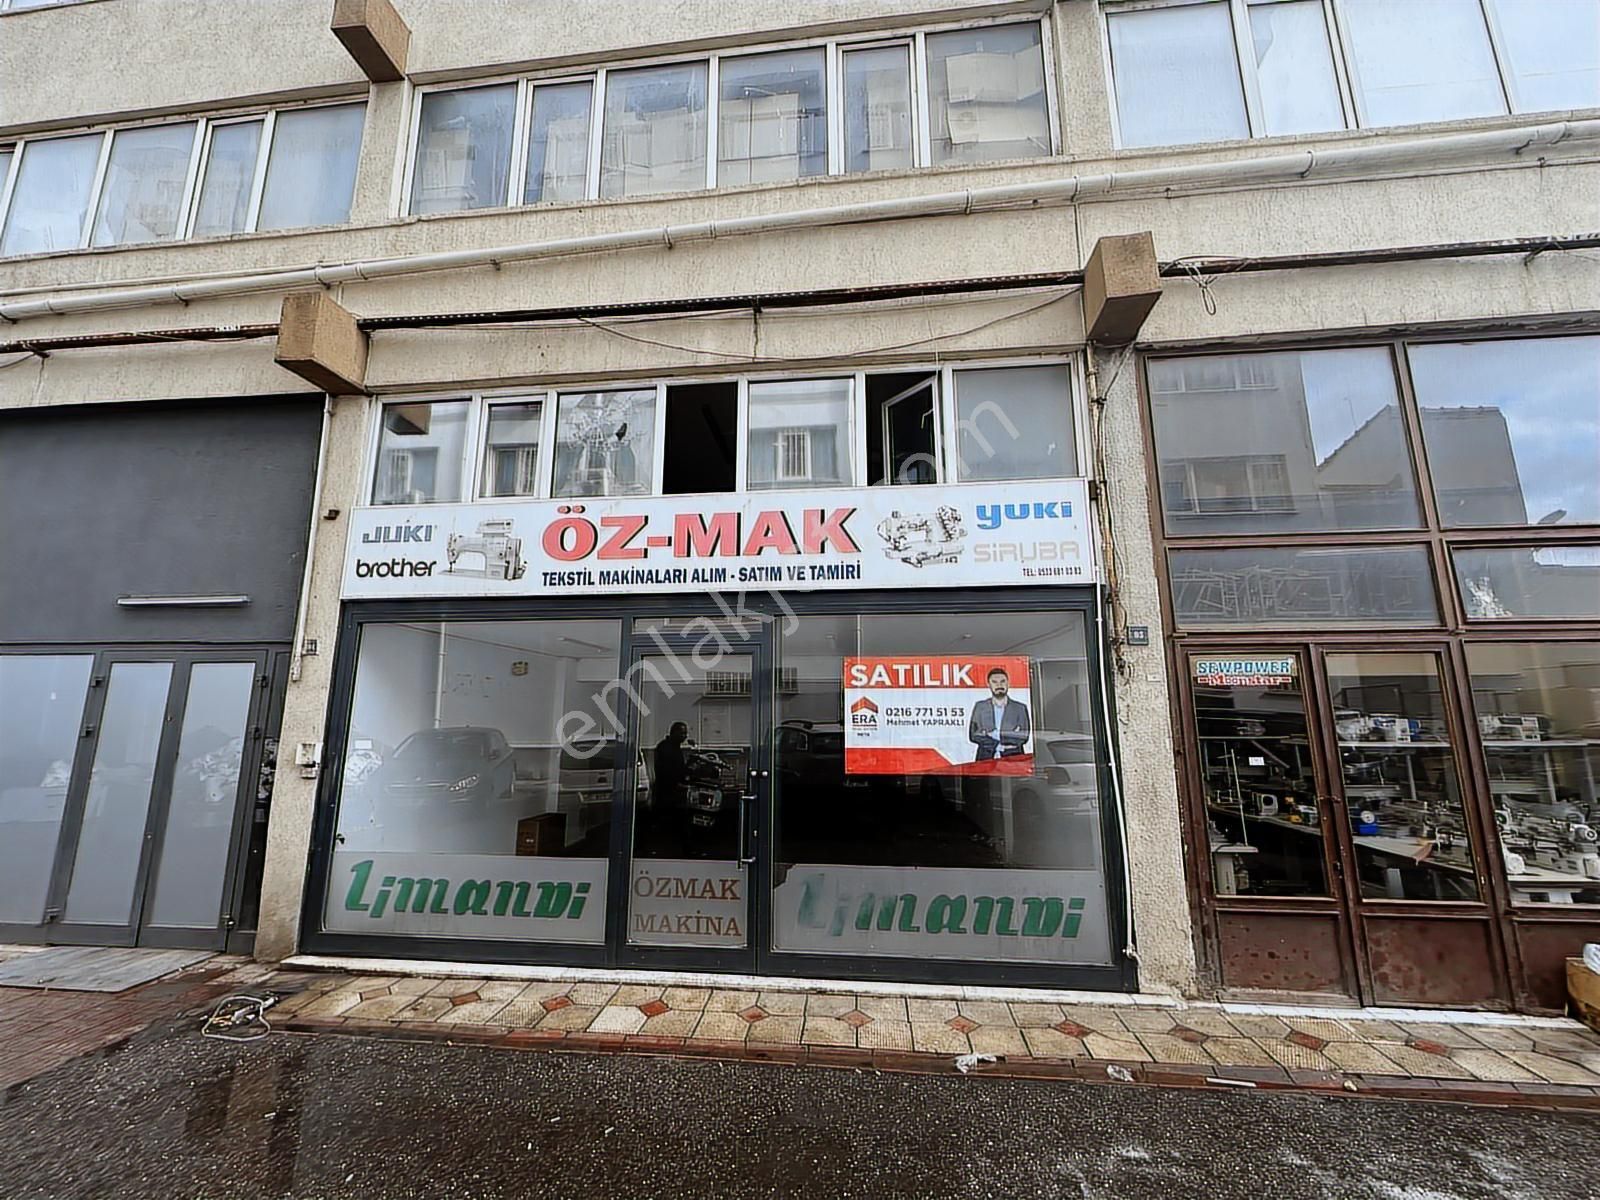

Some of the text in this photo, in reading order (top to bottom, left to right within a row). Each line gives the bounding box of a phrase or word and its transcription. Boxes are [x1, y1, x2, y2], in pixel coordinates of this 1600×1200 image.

[362, 524, 434, 543] JUKI
[541, 504, 862, 561] ÖZ-MAK
[355, 557, 437, 578] brother
[542, 566, 595, 587] TEKSTİL
[598, 565, 688, 586] MAKİNALARI
[691, 567, 727, 584] ALIM
[738, 565, 782, 583] SATIM
[787, 564, 806, 581] VE
[809, 559, 861, 580] TAMİRİ
[850, 663, 974, 687] SATILIK
[1197, 660, 1290, 674] SEWPOWER
[851, 712, 877, 724] ERA
[885, 707, 965, 717] 0216 771 51 53
[886, 717, 965, 727] Mehmet YAPRAKLI
[633, 870, 741, 900] ÖZMAK
[634, 909, 742, 937] MAKİNA
